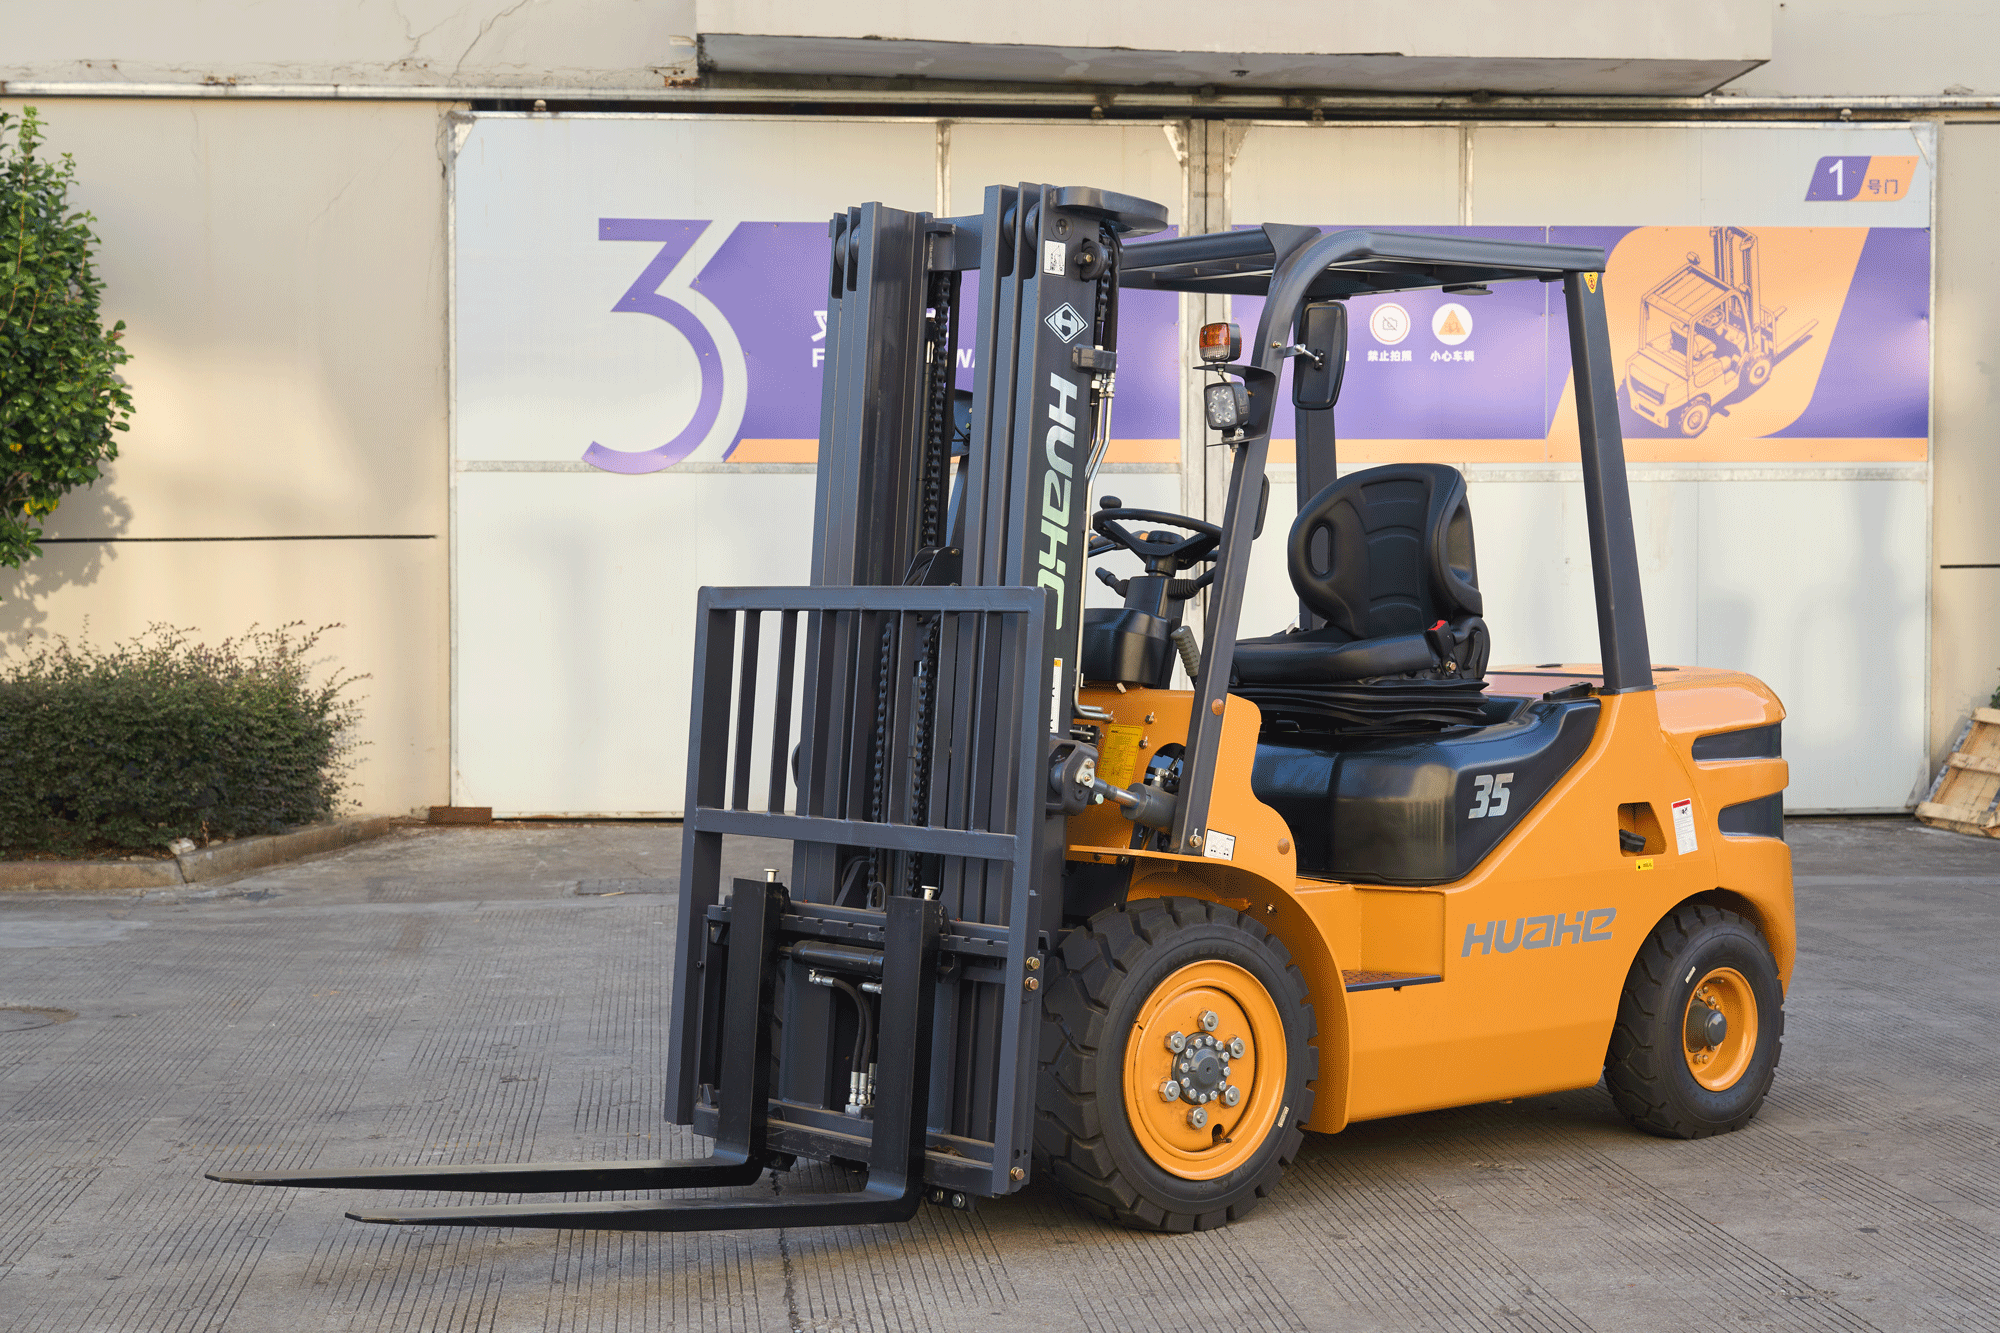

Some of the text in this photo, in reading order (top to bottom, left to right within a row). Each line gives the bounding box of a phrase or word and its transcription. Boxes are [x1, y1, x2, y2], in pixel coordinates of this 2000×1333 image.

[1828, 159, 1899, 196] 1 号门
[581, 217, 724, 475] 3
[1367, 350, 1412, 362] 禁止拍照
[1430, 350, 1475, 362] 小心车辆
[1467, 772, 1515, 820] 35
